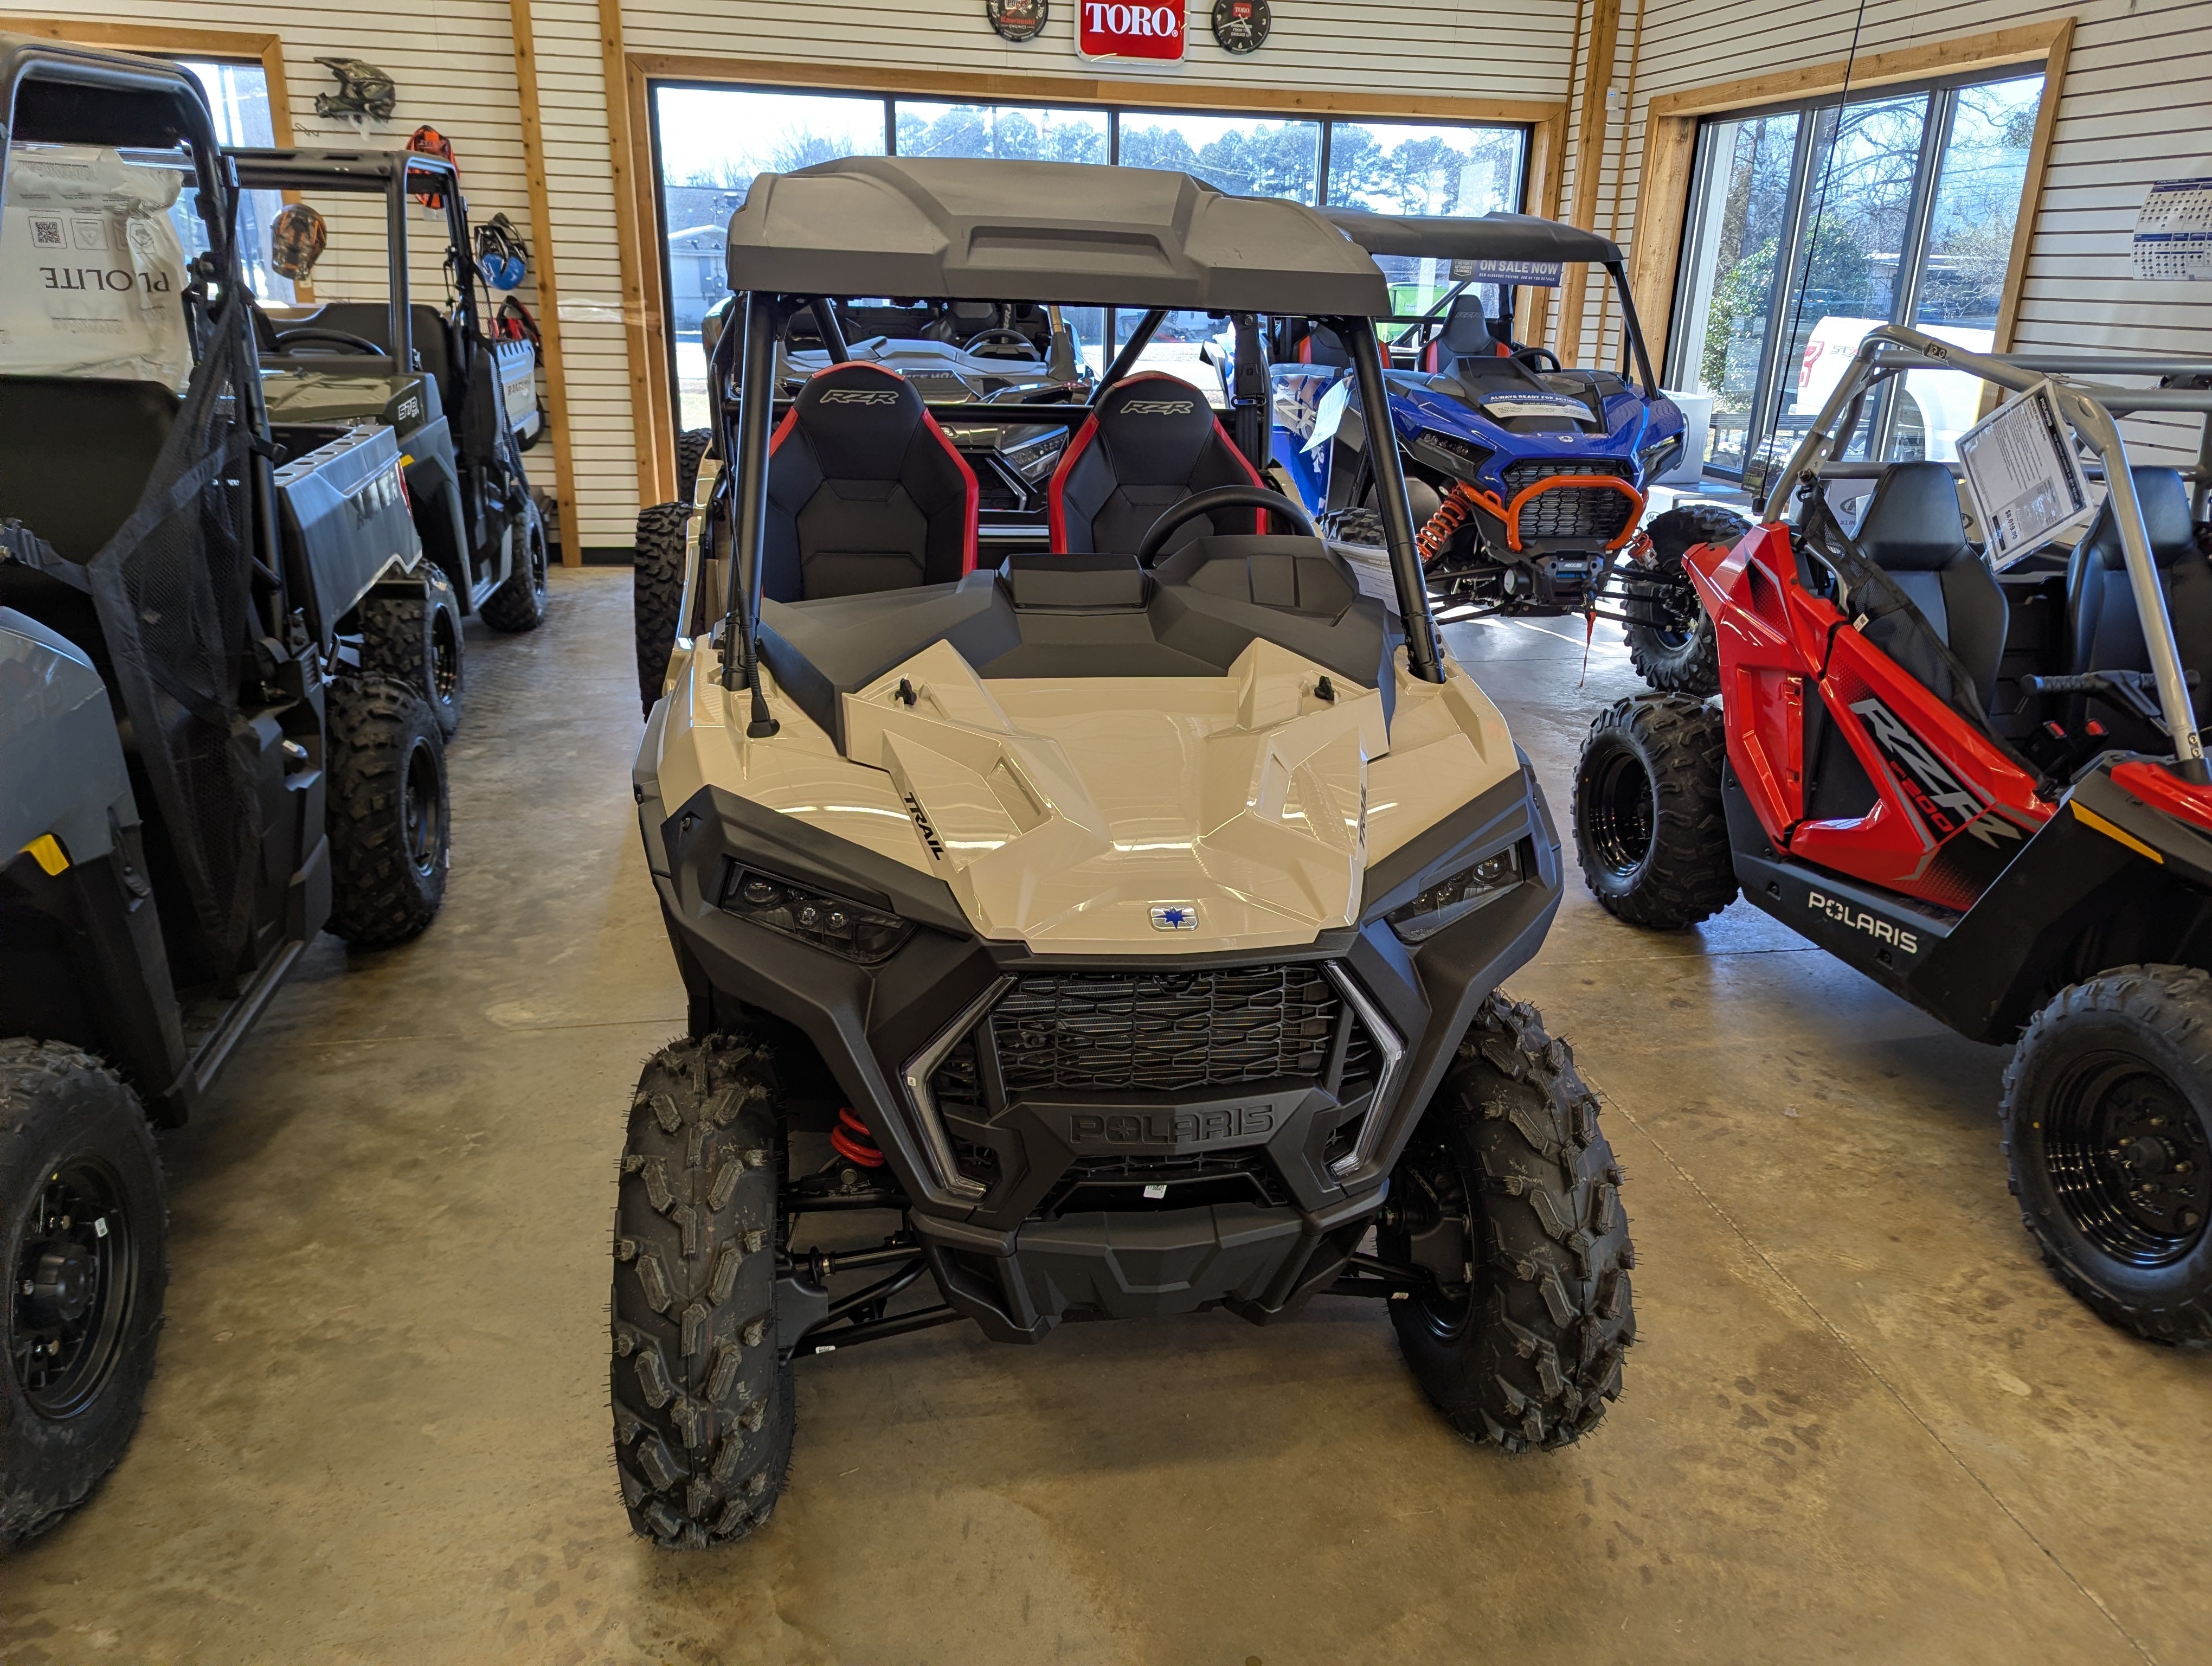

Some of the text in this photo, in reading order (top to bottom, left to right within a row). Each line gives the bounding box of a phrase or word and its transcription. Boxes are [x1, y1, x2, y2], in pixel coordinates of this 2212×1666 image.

[1001, 16, 1035, 24] Kawasaki
[1086, 3, 1175, 36] TORO
[1480, 260, 1558, 274] ON SALE NOW
[398, 396, 417, 420] 570
[820, 389, 899, 405] RZR
[1120, 400, 1194, 415] RZR
[2039, 396, 2053, 427] POLARIS
[2003, 508, 2019, 540] $8,019.00
[1849, 698, 2022, 849] RZR
[1901, 779, 1954, 832] 200
[904, 792, 944, 861] TRAIL
[1808, 891, 1918, 954] POLARIS
[1070, 1104, 1273, 1144] POLARIS
